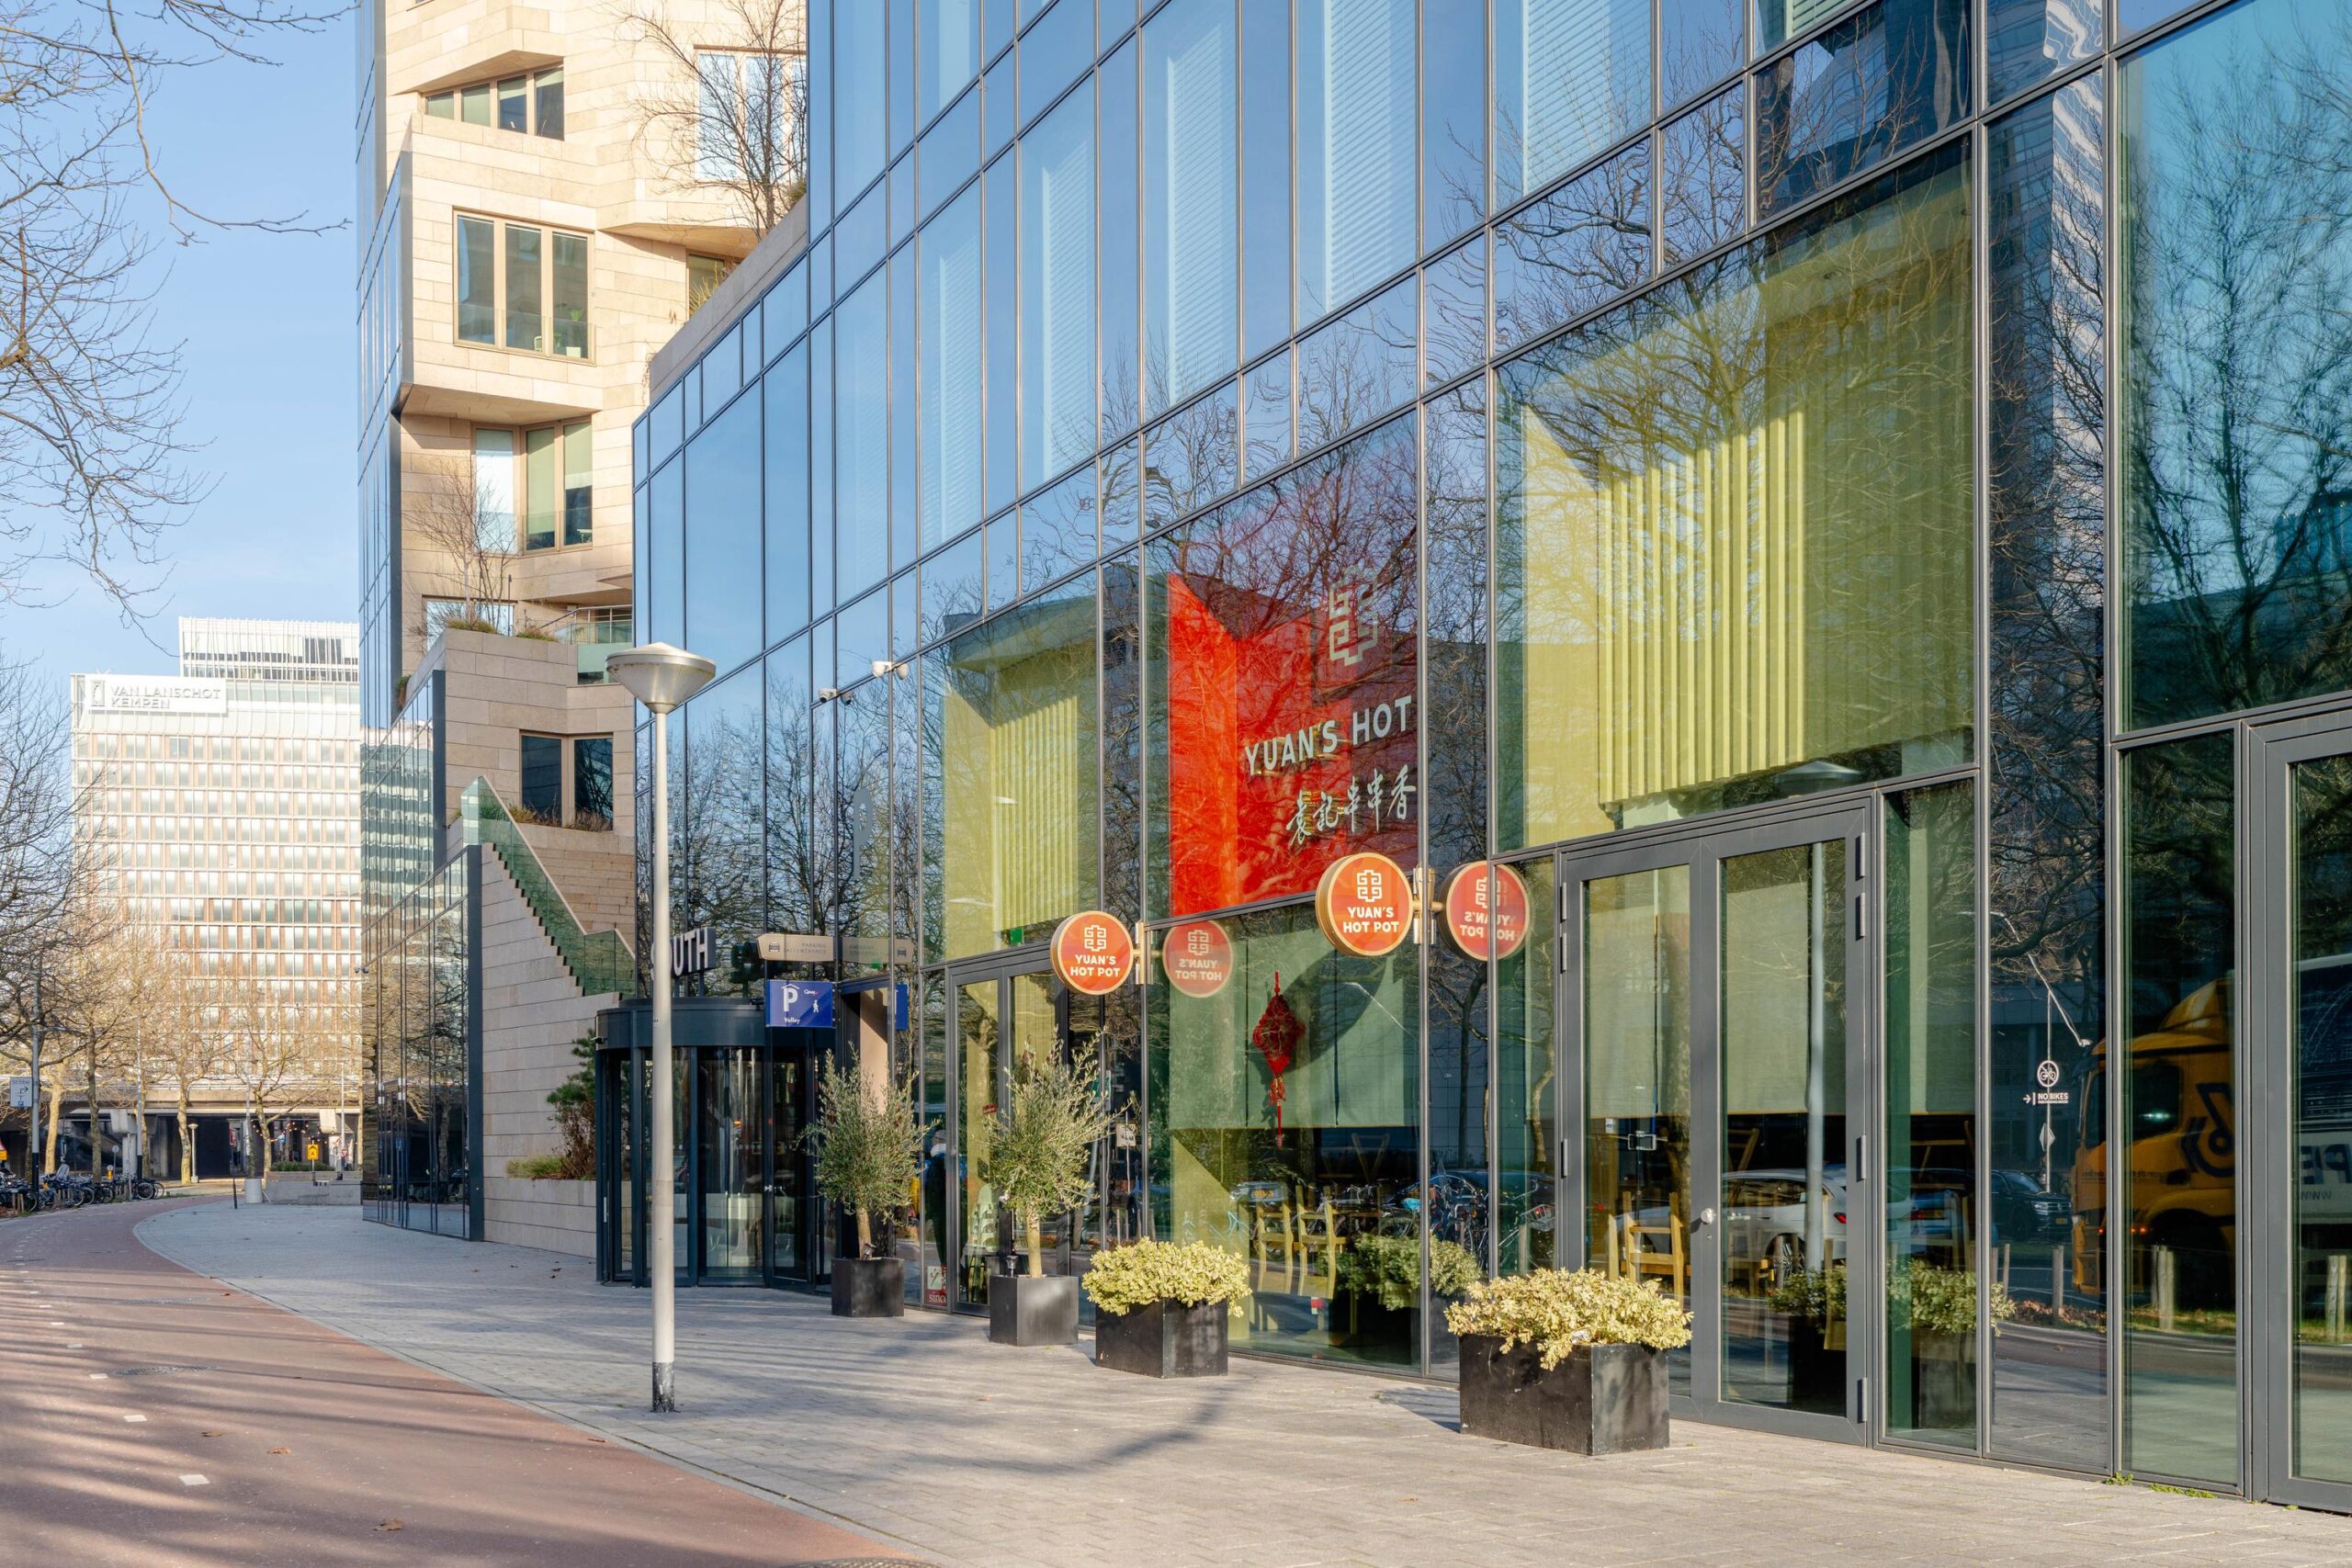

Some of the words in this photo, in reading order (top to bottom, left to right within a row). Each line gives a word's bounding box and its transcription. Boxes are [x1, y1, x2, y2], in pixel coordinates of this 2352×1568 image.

[111, 685, 138, 697] VAN
[144, 686, 221, 699] LANSCHOT
[111, 697, 170, 709] KEMPEN
[1245, 719, 1339, 776] YUAN'S
[1352, 694, 1412, 746] HOT
[1347, 906, 1395, 919] YUAN'S
[1342, 921, 1370, 933] HOT
[1374, 920, 1400, 933] POT
[1075, 954, 1116, 965] YUAN'S
[1070, 967, 1094, 976] HOT
[1097, 967, 1120, 977] POT
[784, 987, 798, 1011] P
[784, 1017, 800, 1025] Valley
[2037, 1092, 2049, 1100] NO
[2049, 1092, 2069, 1100] BIKES
